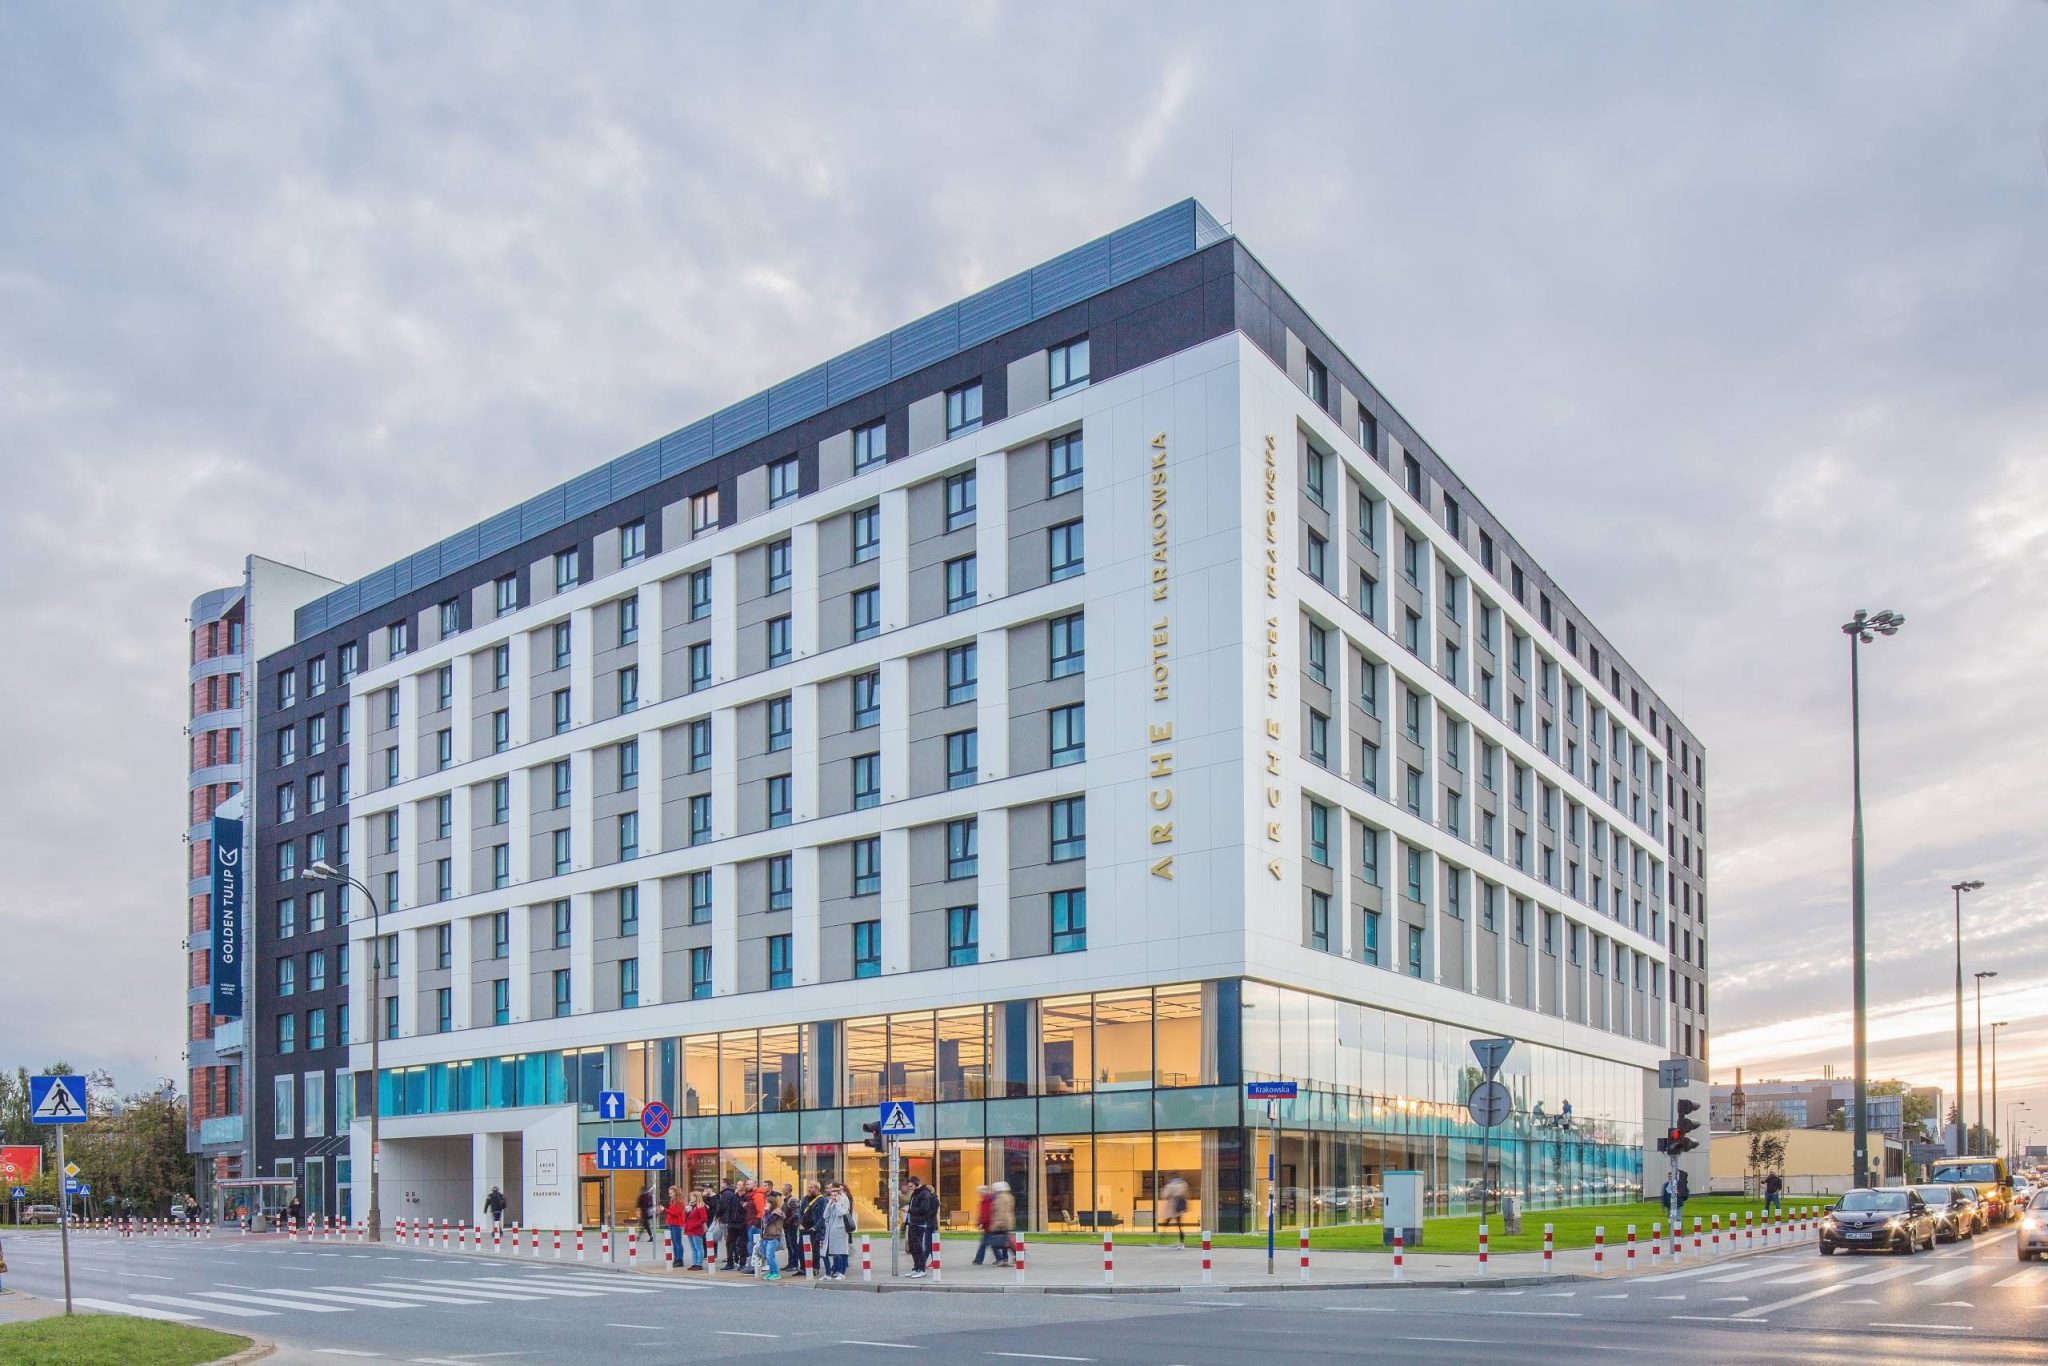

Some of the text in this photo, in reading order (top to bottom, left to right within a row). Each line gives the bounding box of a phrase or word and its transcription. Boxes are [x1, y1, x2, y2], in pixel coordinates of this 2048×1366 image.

[1150, 431, 1173, 881] ARCHE HOTEL KRAKOWSKA
[1265, 432, 1282, 881] ARCHE HOTEL KRAKOWSKA
[223, 869, 234, 964] GOLDEN TULIP
[1255, 1086, 1290, 1094] Krakowska
